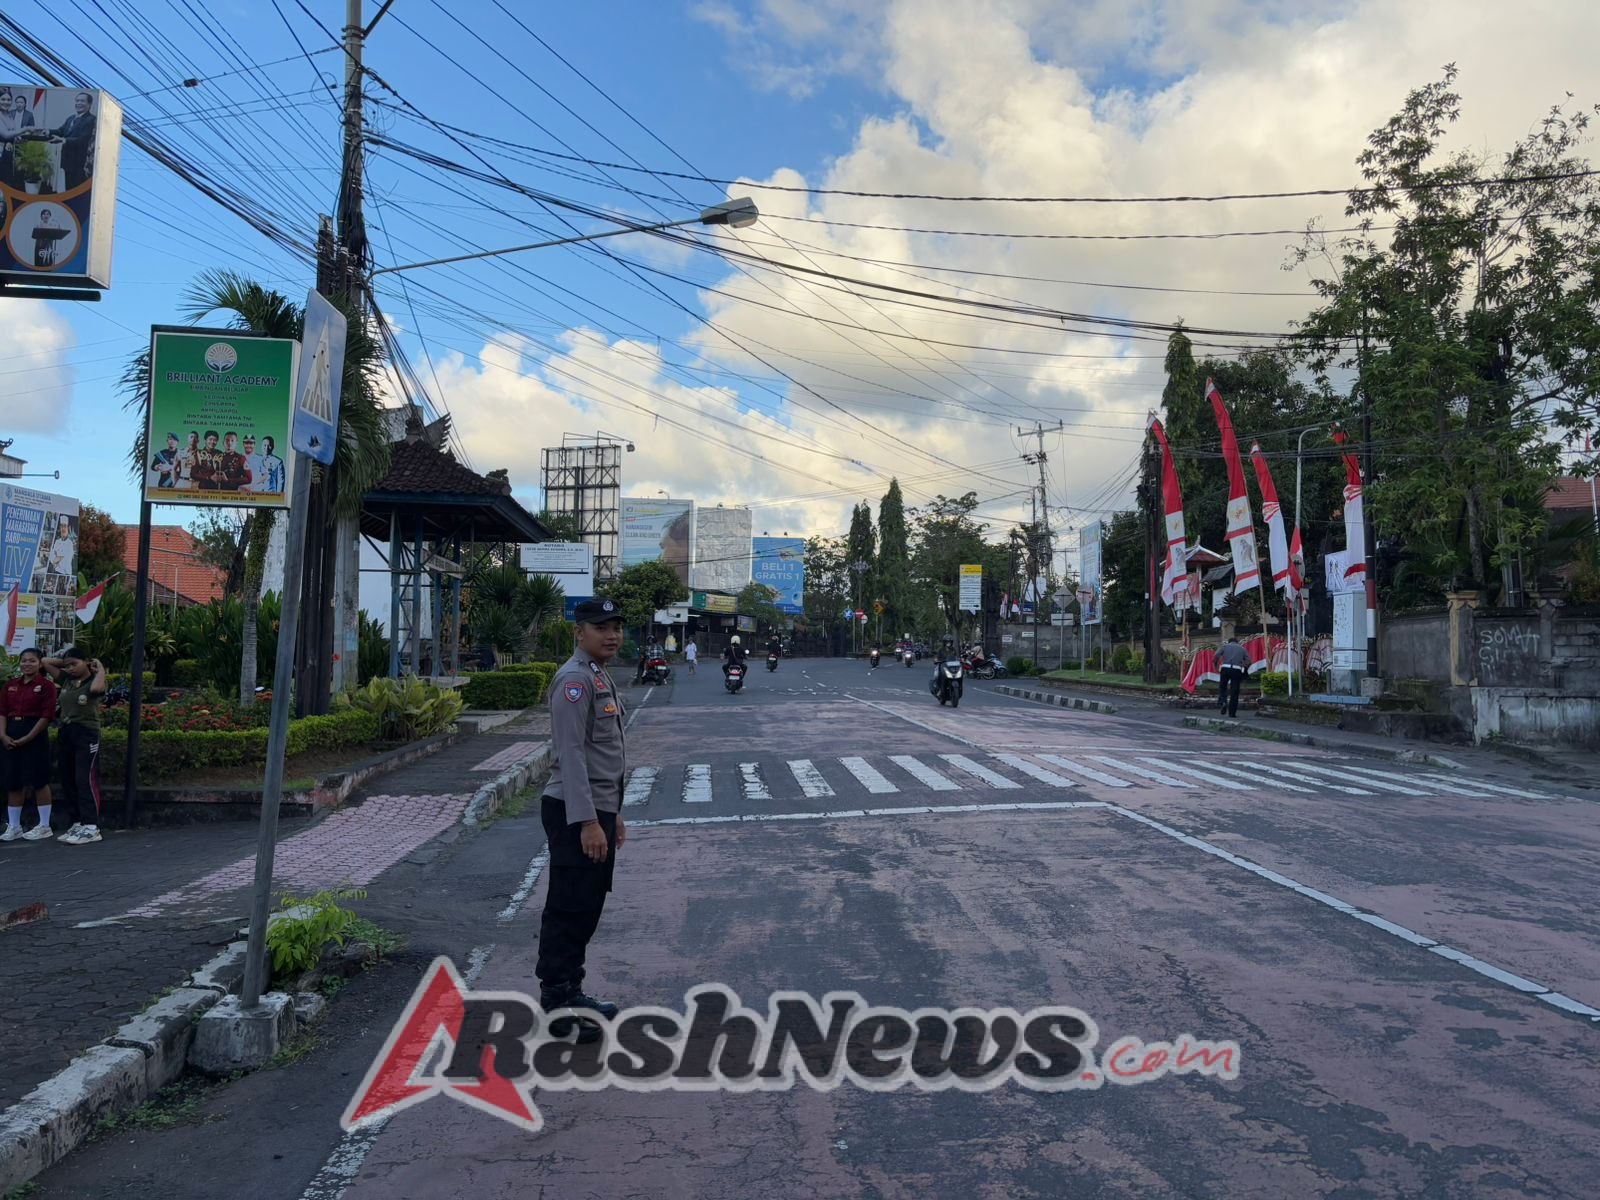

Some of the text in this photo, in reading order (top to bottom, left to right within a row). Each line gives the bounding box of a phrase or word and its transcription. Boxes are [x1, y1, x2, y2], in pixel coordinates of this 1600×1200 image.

[167, 371, 278, 387] BRILLIANT ACADEMY
[6, 506, 41, 523] PENERIMAAN
[5, 520, 39, 536] MAHASISWA
[4, 531, 21, 544] BARU
[4, 545, 31, 577] IV
[761, 562, 794, 571] BELI 1
[755, 572, 792, 580] GRATIS
